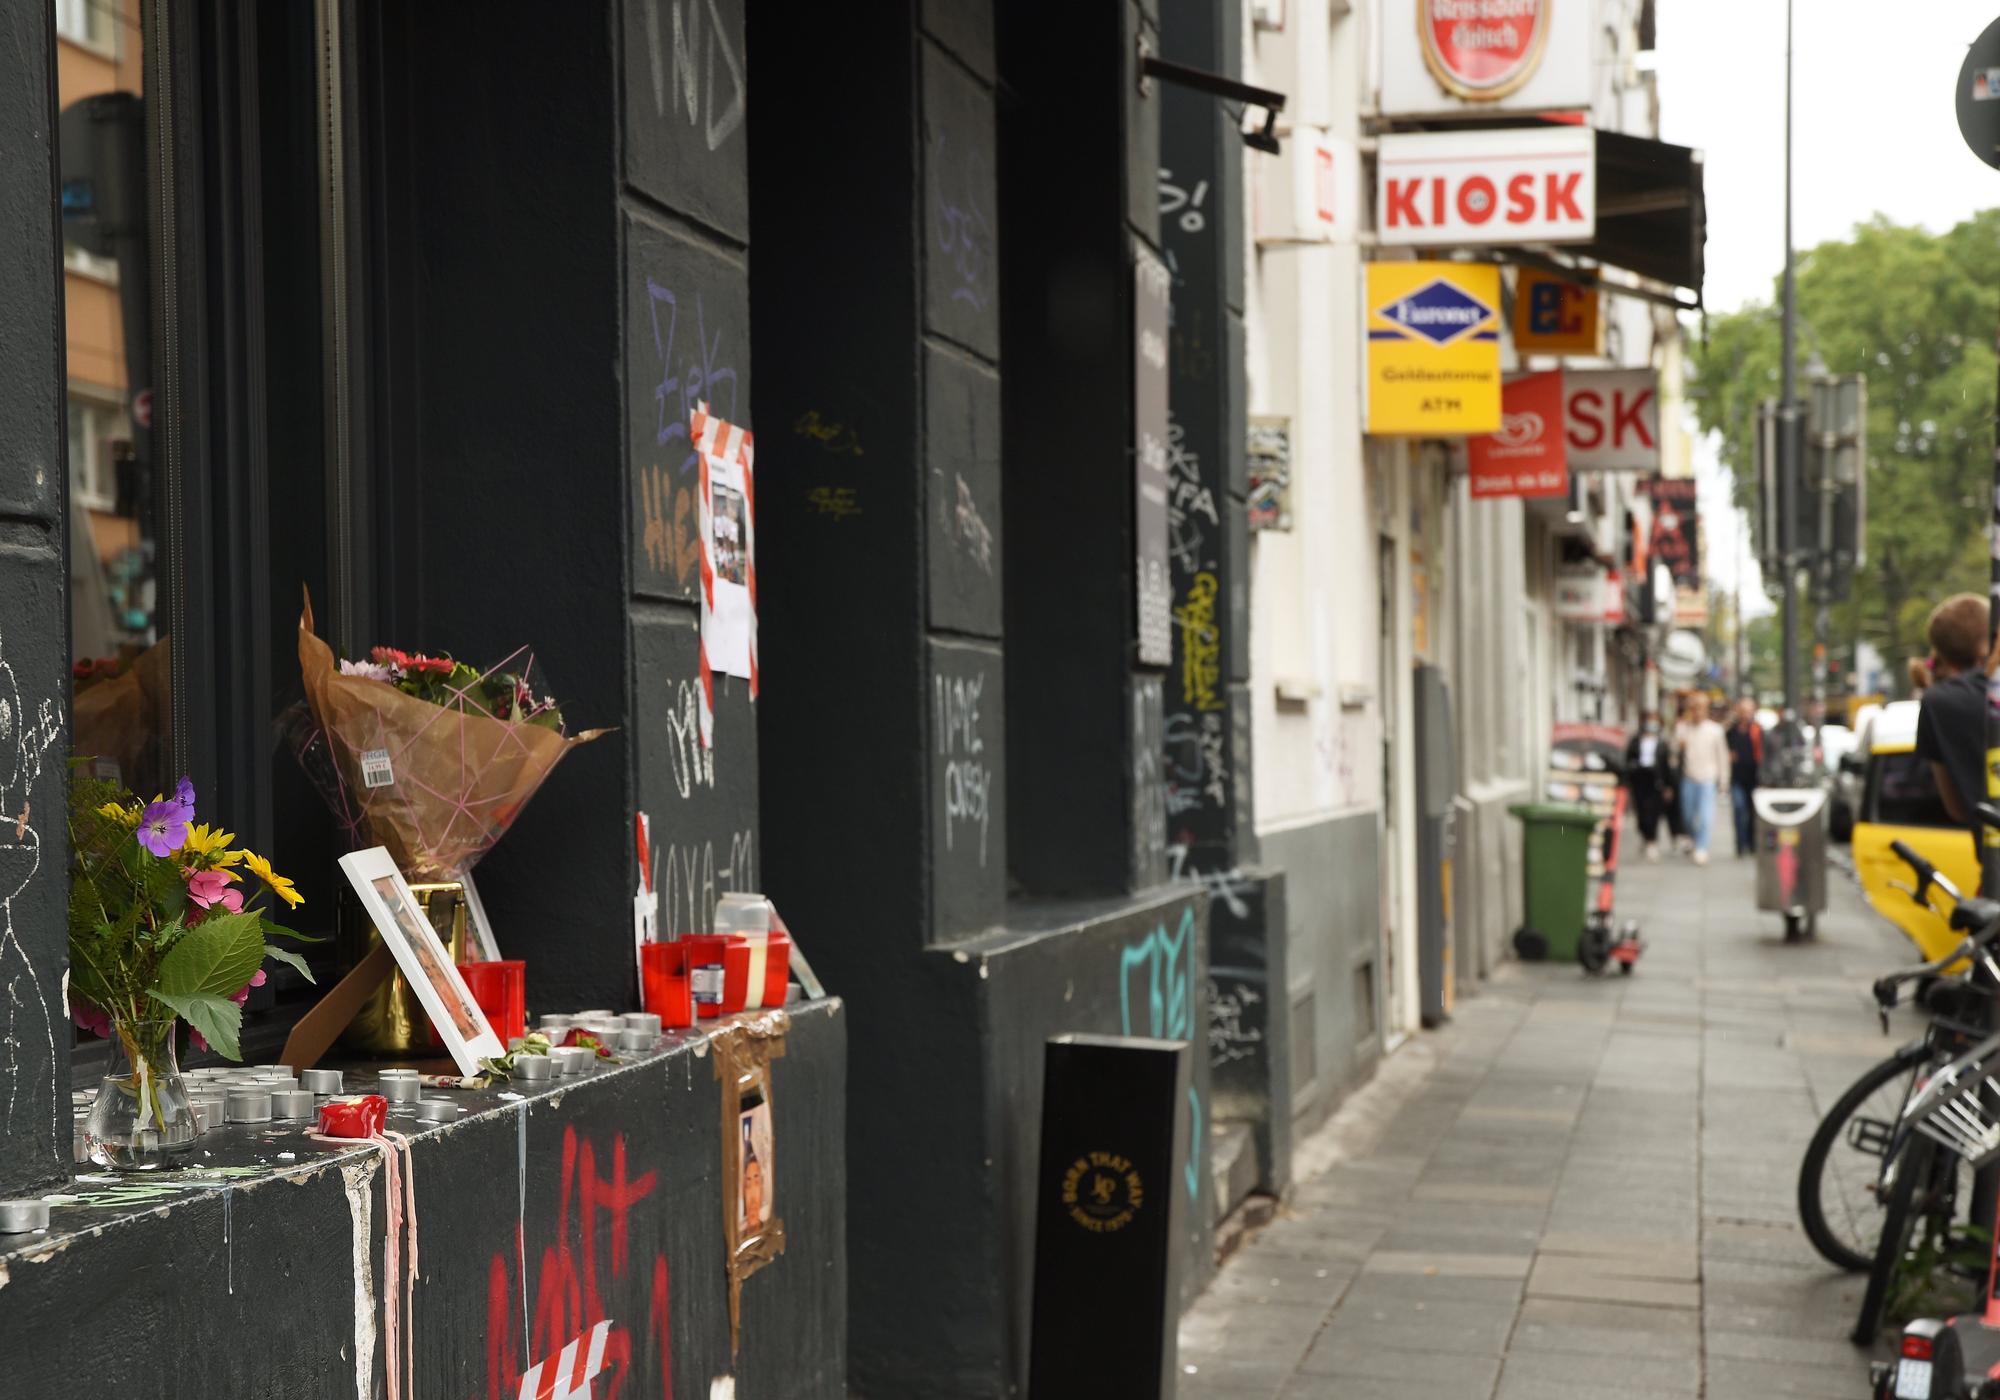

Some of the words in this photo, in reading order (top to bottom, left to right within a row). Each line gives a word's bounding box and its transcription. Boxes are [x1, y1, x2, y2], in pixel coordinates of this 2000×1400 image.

[1386, 171, 1584, 227] KIOSK
[1420, 396, 1462, 413] ATM
[1062, 1157, 1089, 1204] BORN
[1089, 1151, 1132, 1173] THAT
[1125, 1171, 1143, 1209] WAY
